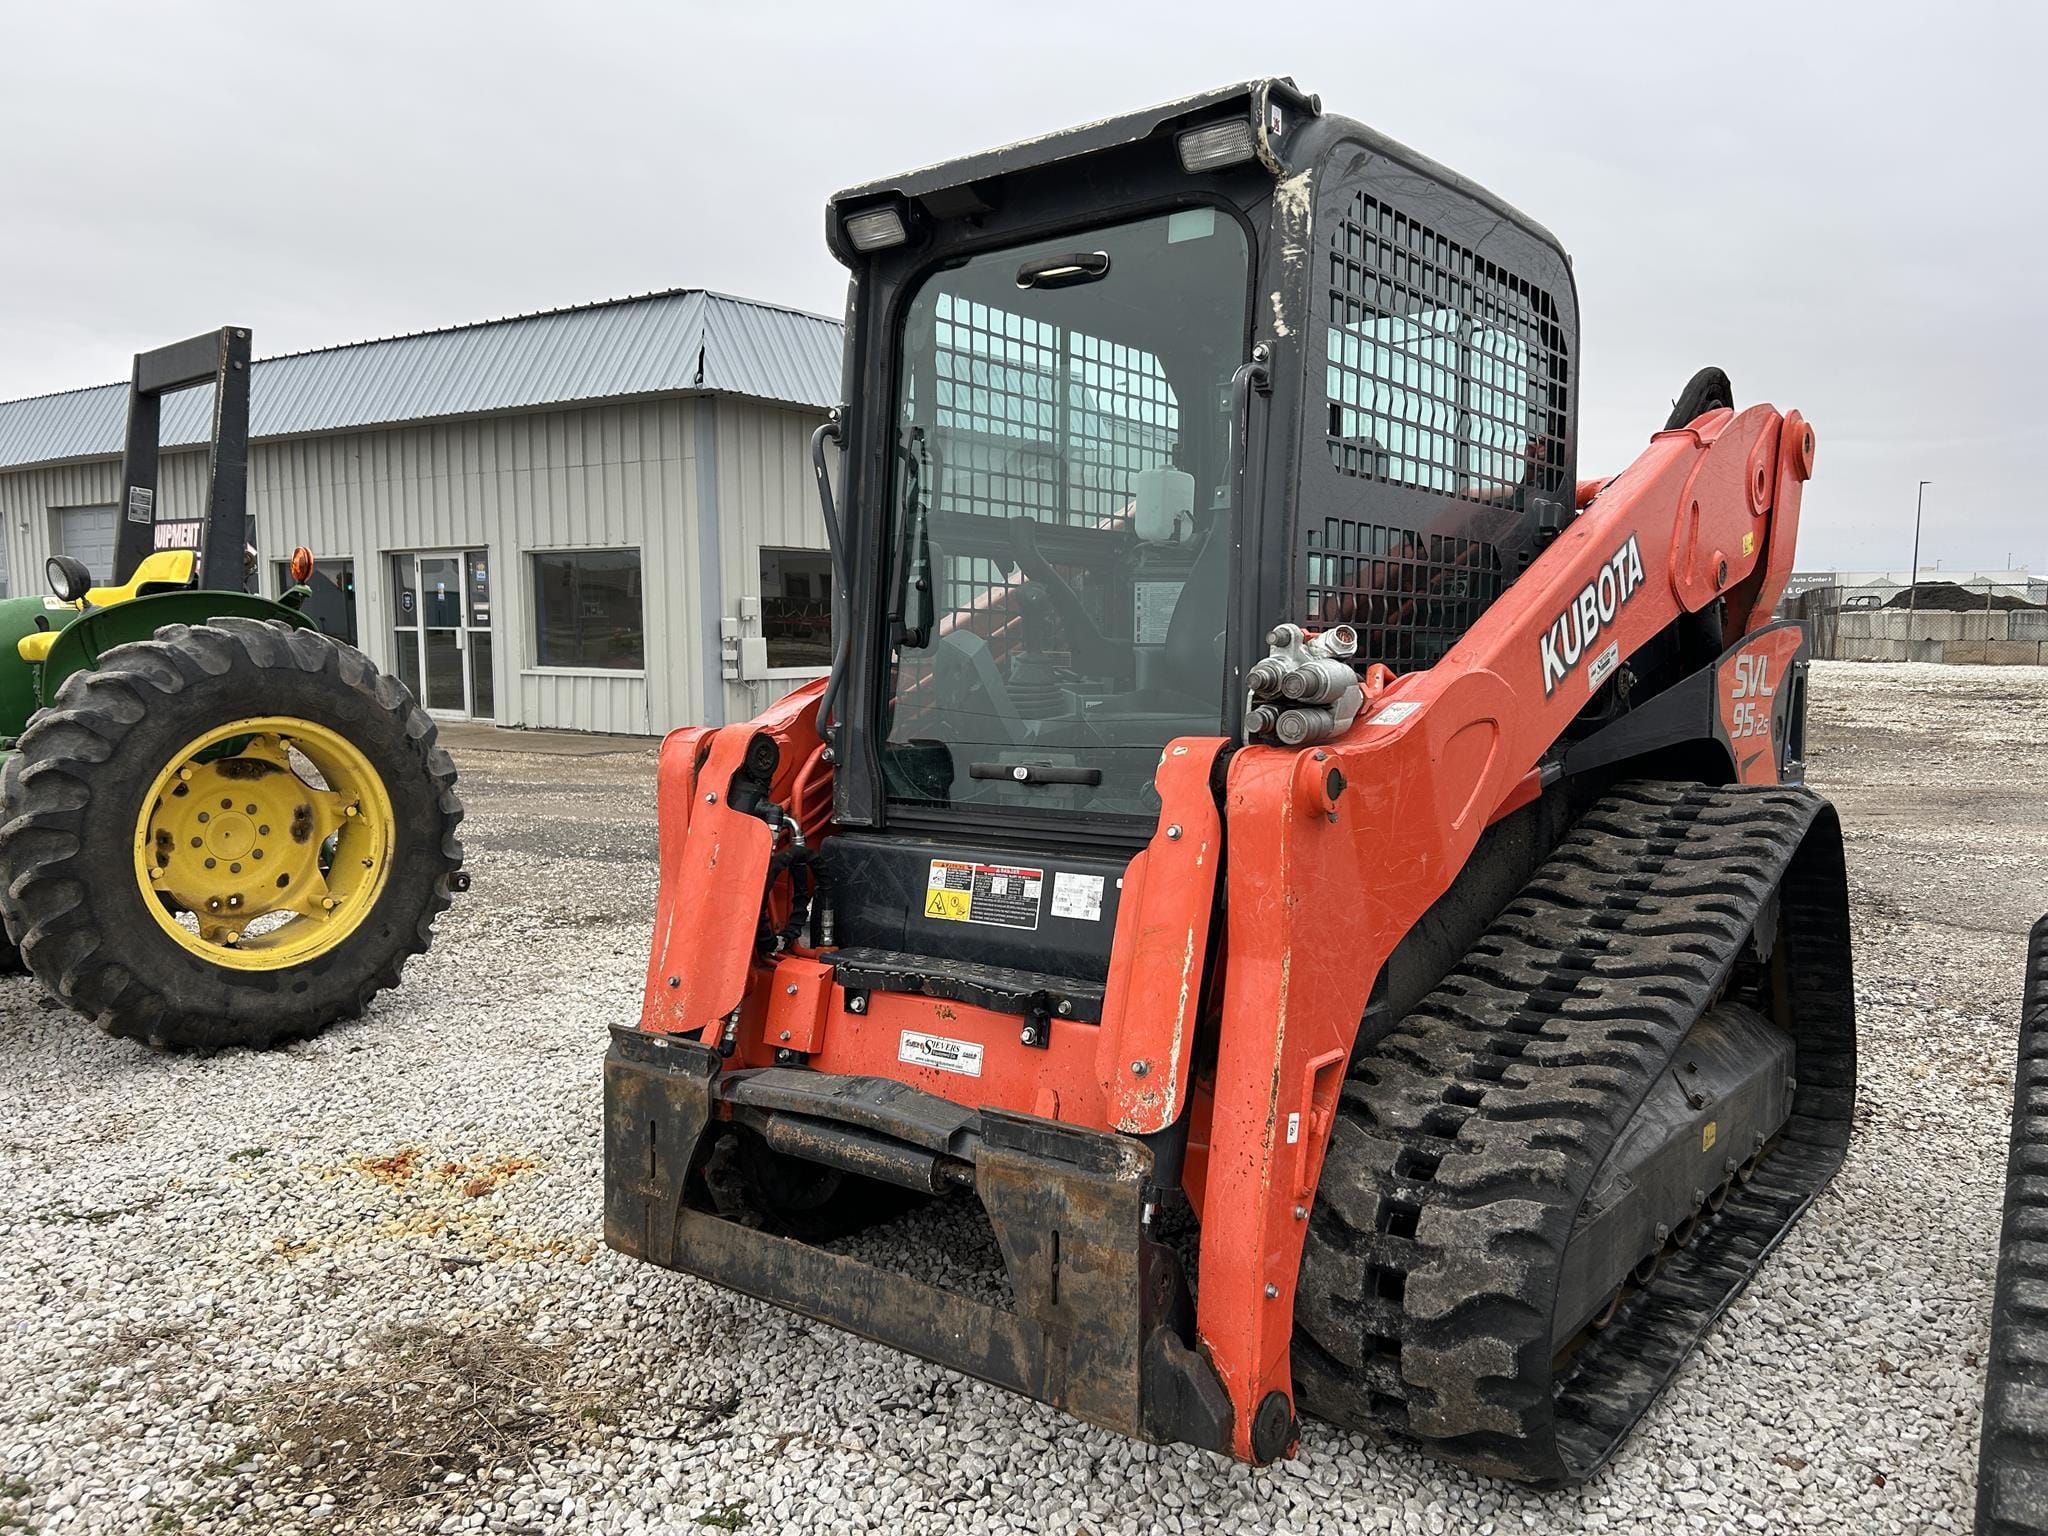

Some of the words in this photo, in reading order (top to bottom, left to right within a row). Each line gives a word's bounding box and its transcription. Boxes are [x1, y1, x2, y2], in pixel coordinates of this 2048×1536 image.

[1540, 534, 1644, 693] KUBOTA
[1731, 654, 1773, 698] SVL
[922, 1039, 960, 1055] SIEVERS
